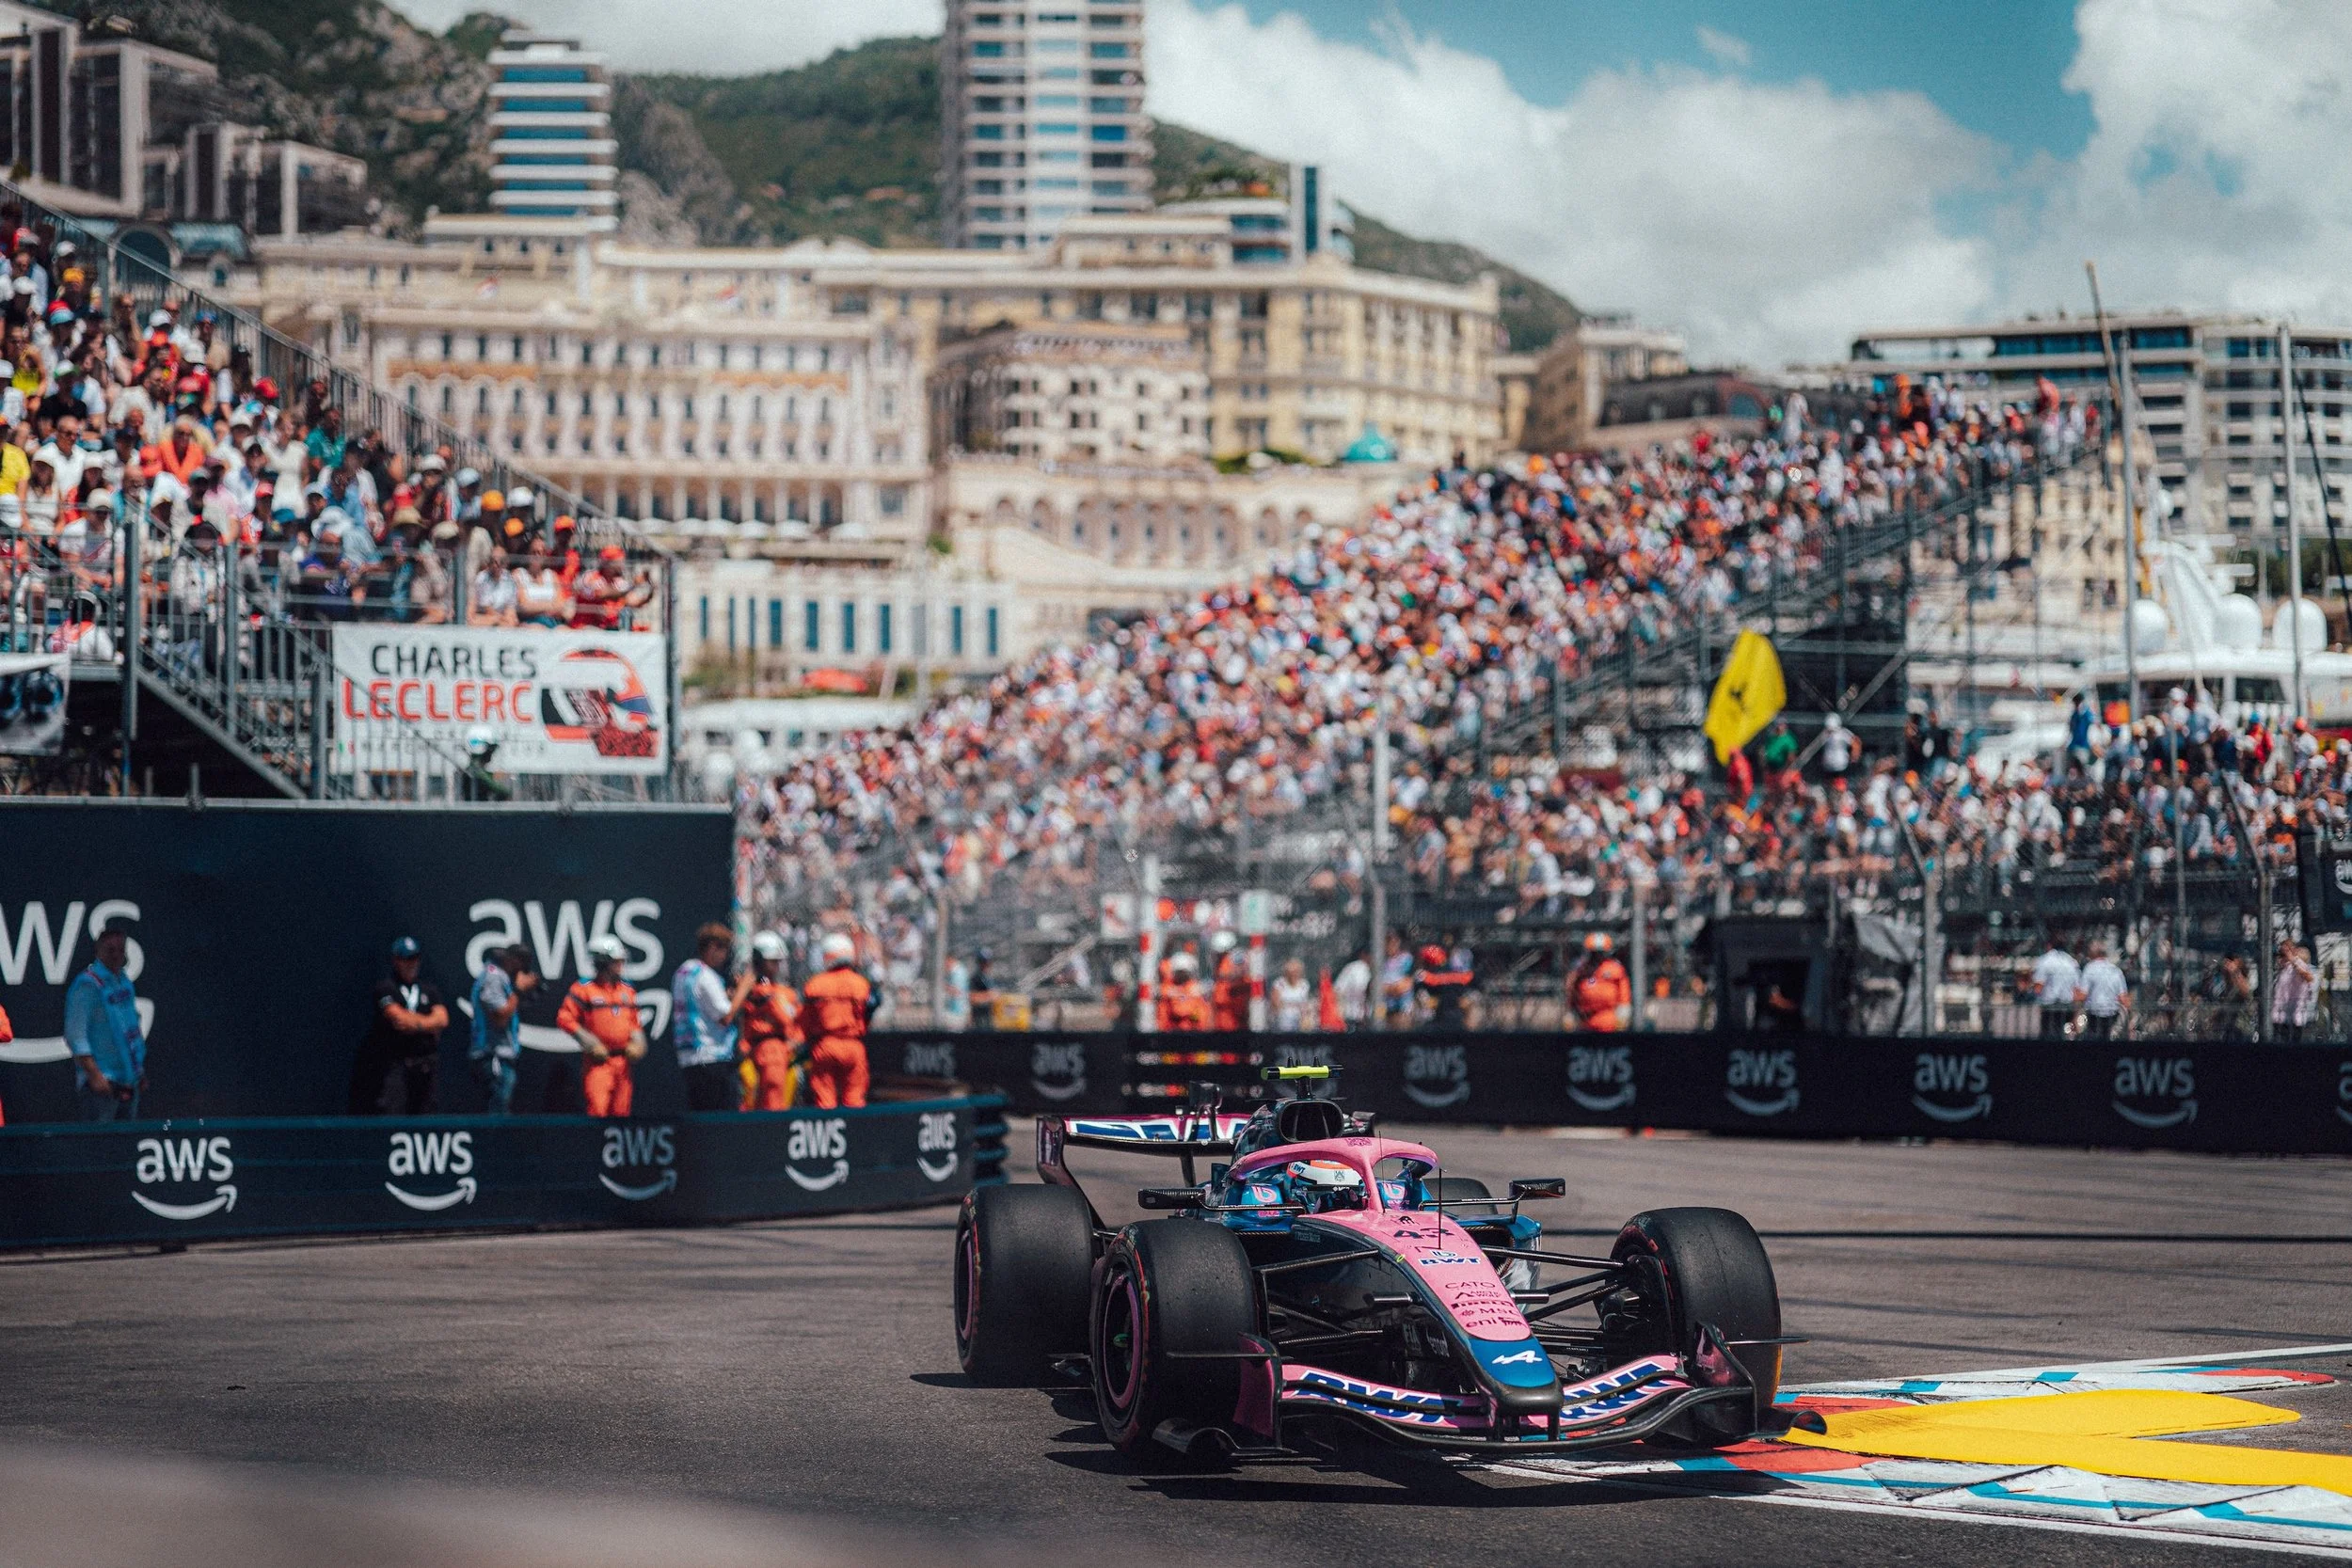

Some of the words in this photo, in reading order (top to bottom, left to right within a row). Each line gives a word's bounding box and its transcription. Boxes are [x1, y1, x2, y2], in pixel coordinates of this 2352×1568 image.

[371, 644, 537, 677] CHARLES
[342, 677, 534, 722] LECLERC
[0, 899, 144, 985] ws
[465, 898, 663, 982] aws
[1405, 1045, 1468, 1081] aws
[1567, 1046, 1633, 1084] aws
[1726, 1049, 1796, 1087] aws
[1914, 1053, 1989, 1093] aws
[2114, 1057, 2195, 1097] aws
[601, 1126, 675, 1167] aws
[787, 1118, 847, 1158] aws
[917, 1112, 956, 1149] aws
[136, 1136, 234, 1182] aws
[389, 1131, 473, 1175] aws
[1466, 1317, 1497, 1327] eni
